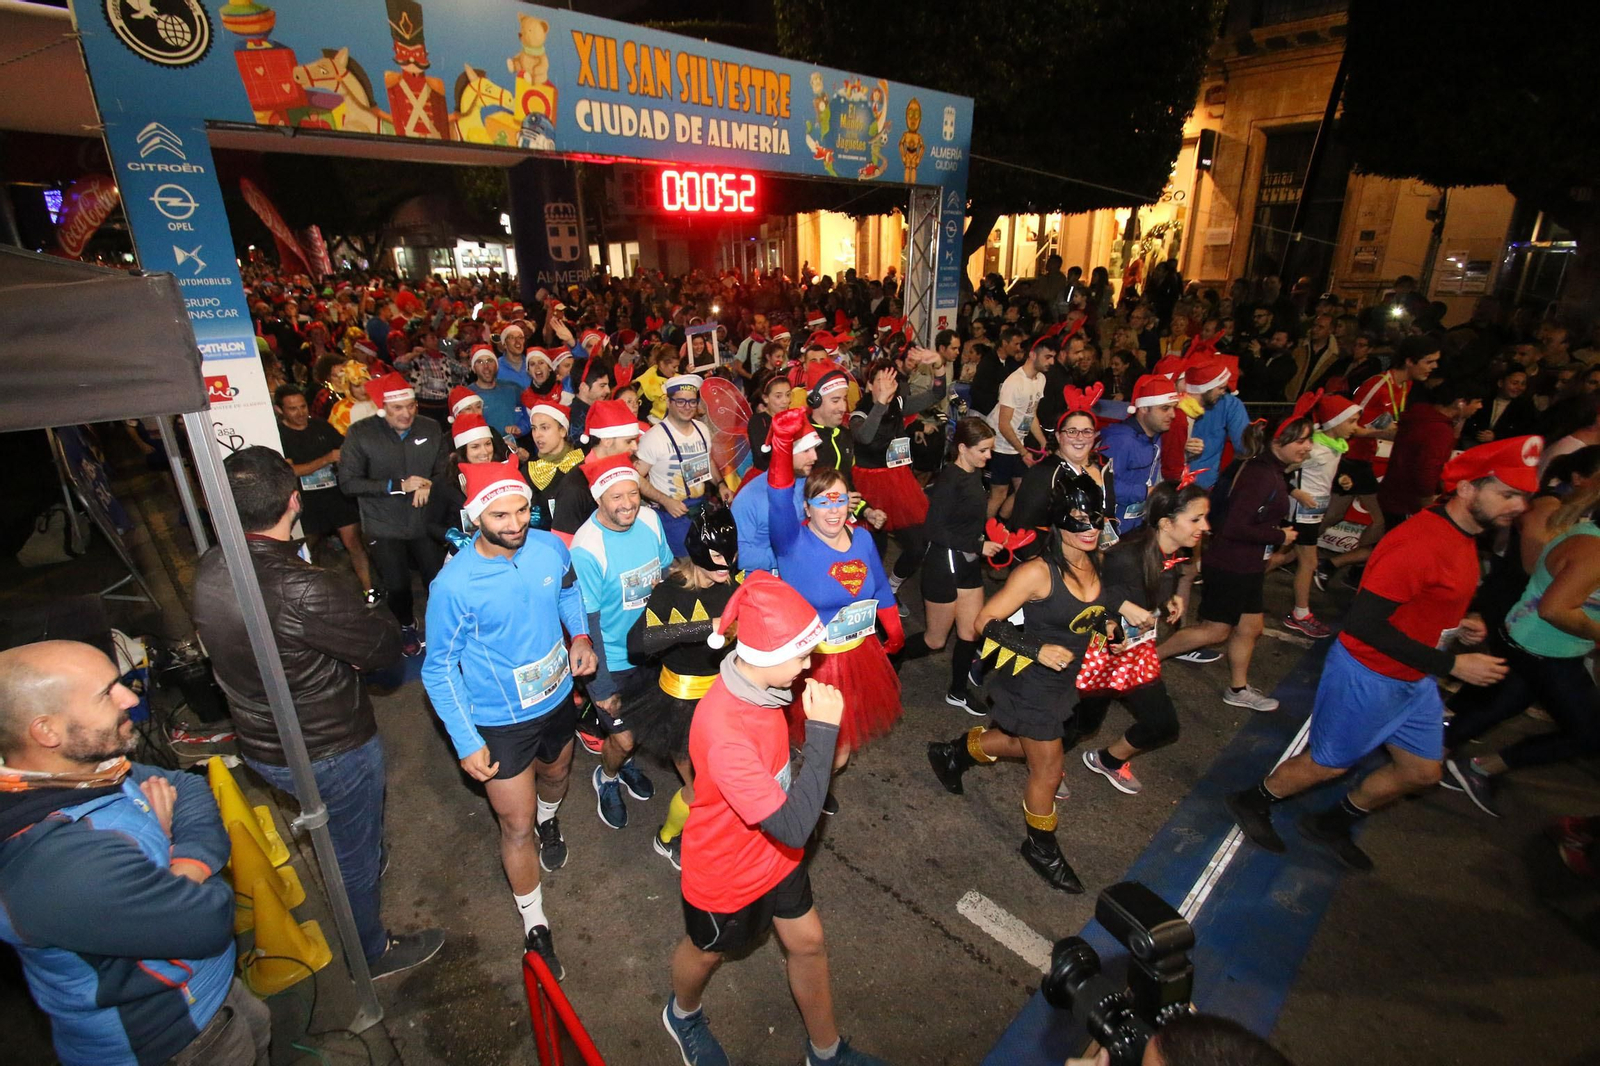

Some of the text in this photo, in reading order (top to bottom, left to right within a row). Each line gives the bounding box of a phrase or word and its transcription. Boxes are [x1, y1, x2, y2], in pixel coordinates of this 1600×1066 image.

[571, 29, 791, 119] XII SAN SILVESTRE
[575, 98, 791, 155] CIUDAD DE ALMERÍA
[930, 145, 963, 160] ALMERÍA
[935, 161, 958, 171] CIUDAD
[168, 222, 195, 232] OPEL
[184, 298, 220, 307] GRUPO
[216, 309, 239, 318] CAR
[847, 608, 873, 626] 2071
